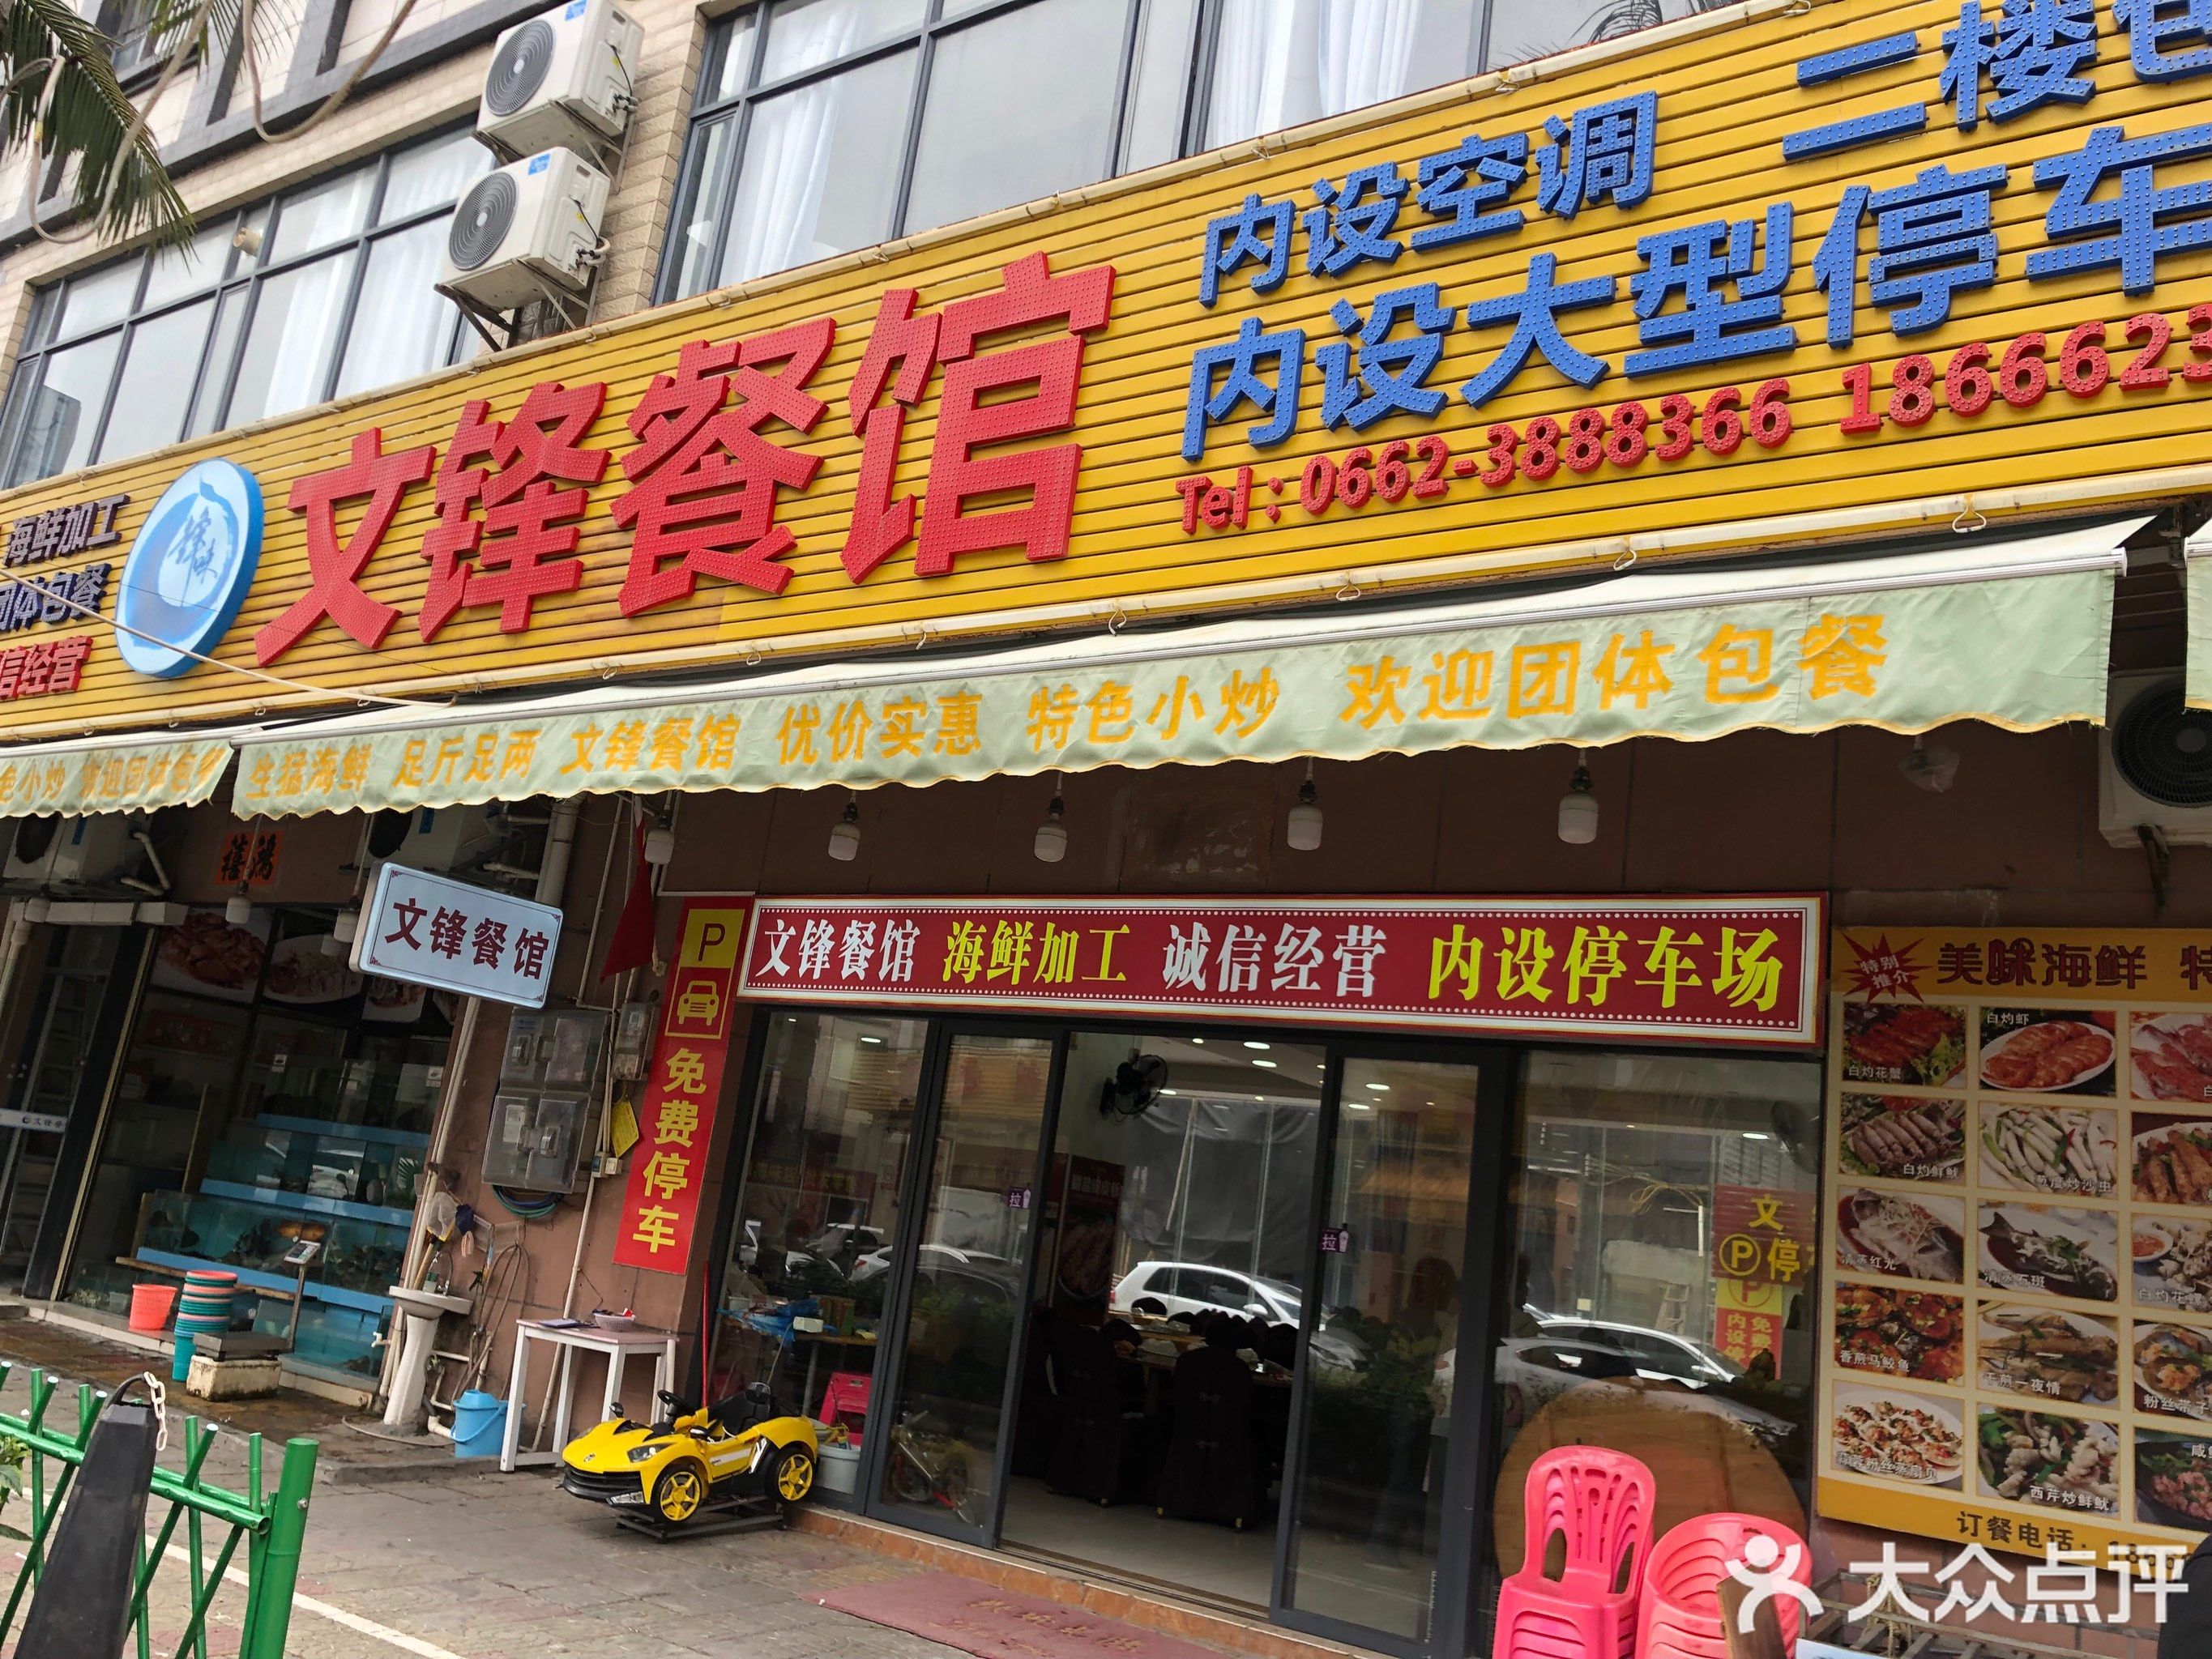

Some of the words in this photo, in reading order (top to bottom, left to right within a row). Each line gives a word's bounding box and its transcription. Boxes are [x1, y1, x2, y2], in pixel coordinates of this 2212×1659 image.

[1199, 90, 1659, 308] 内设空调
[1181, 123, 2212, 462] 内设大型停车
[254, 252, 1116, 666] 文锋餐馆
[1300, 378, 1792, 516] 0662-3888366
[1, 493, 130, 568] 海鲜加工
[246, 743, 372, 800] 生猛海鲜
[392, 729, 541, 788] 足斤足两
[560, 713, 741, 775] 文锋餐馆
[776, 690, 984, 766] 优价实惠
[1026, 667, 1279, 753] 特色小炒
[1339, 612, 1889, 731] 欢迎团体包餐
[385, 898, 549, 980] 文锋餐馆
[755, 919, 920, 983] 文锋餐馆
[942, 920, 1131, 986] 海鲜加工
[1161, 922, 1386, 997] 诚信经营
[1428, 923, 1784, 1010] 内设停车场
[1937, 938, 2147, 989] 美味海鲜
[1987, 1011, 2030, 1026] 白灼虾
[632, 1047, 707, 1253] 免费停车
